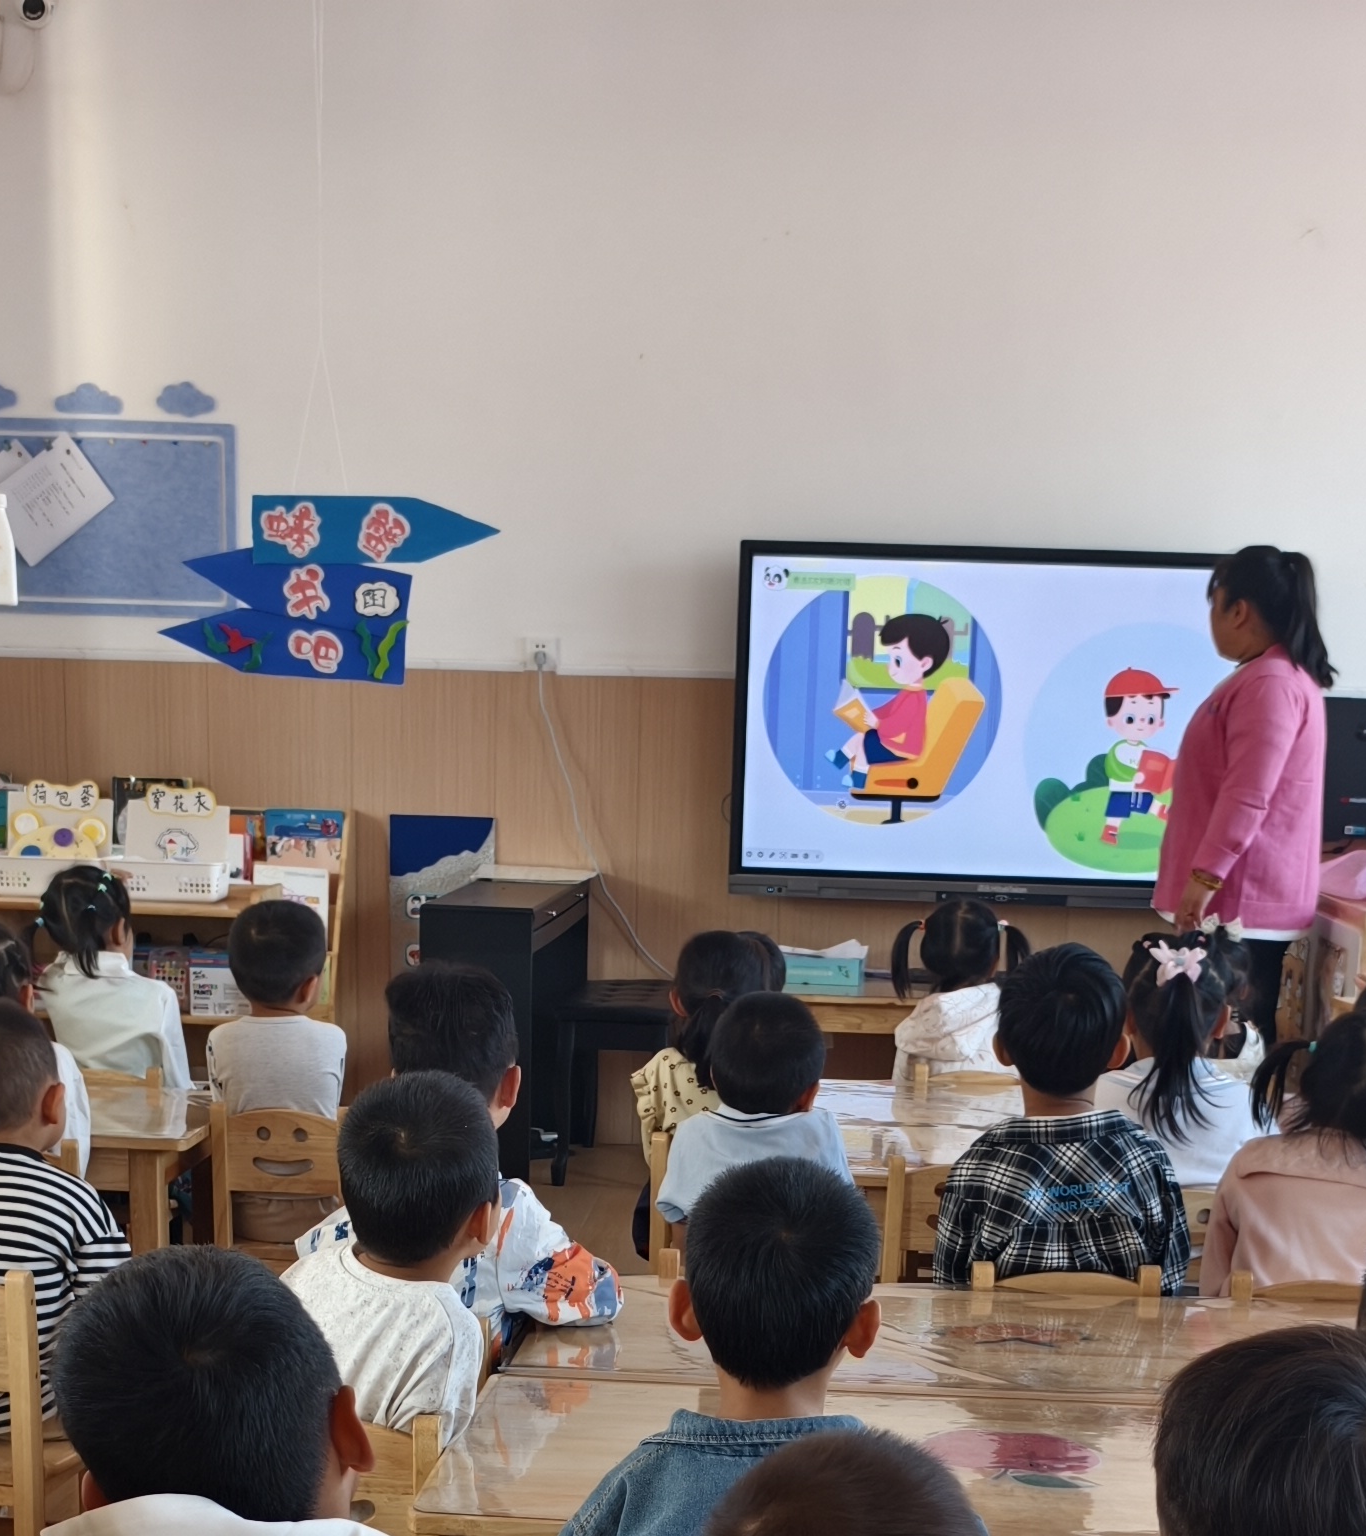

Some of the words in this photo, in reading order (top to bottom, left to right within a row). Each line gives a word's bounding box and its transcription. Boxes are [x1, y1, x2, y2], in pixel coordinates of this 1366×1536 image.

[288, 567, 326, 616] 书
[293, 634, 339, 669] 吧
[32, 783, 95, 808] 荷包蛋
[151, 787, 211, 813] 穿花衣
[1047, 1182, 1095, 1198] WORLD
